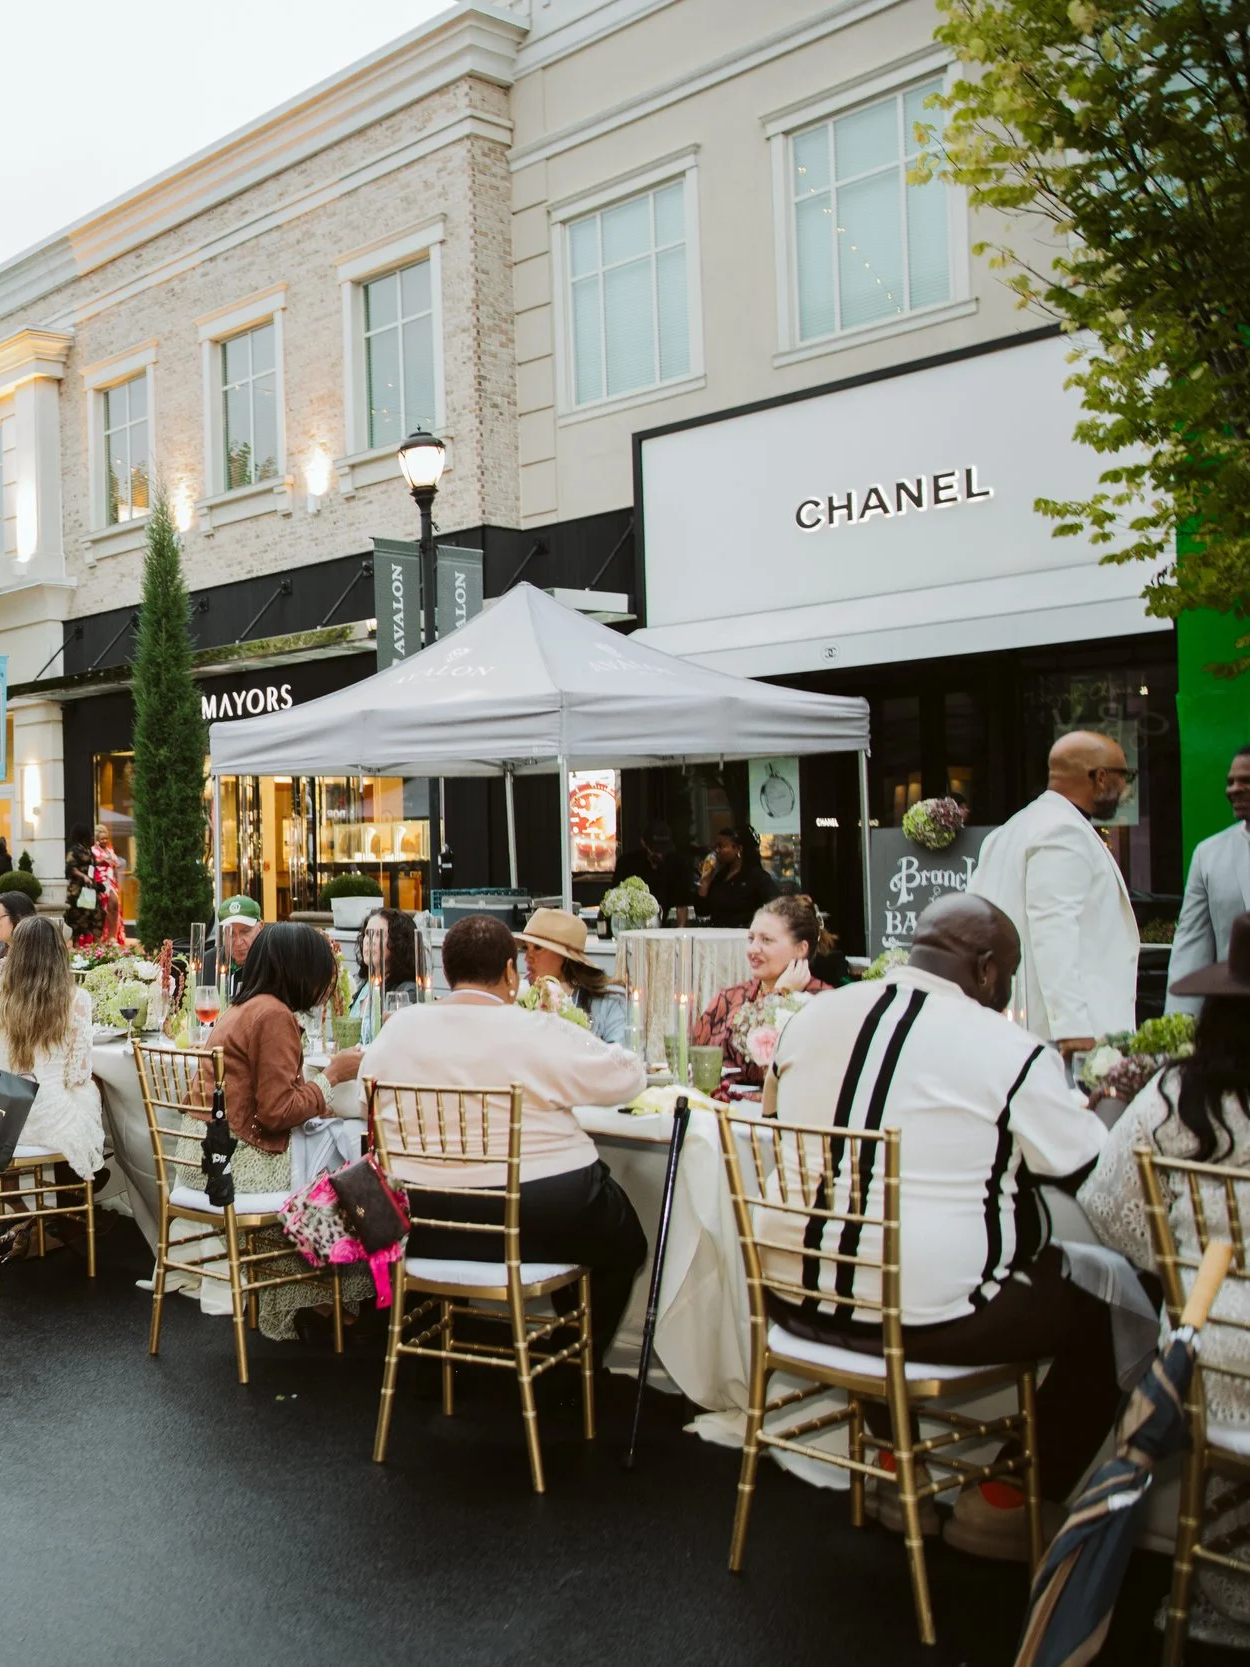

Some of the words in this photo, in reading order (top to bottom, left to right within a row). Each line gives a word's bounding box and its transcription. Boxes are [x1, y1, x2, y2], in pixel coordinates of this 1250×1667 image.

[795, 467, 991, 530] CHANEL
[391, 563, 406, 656] AVALON
[201, 683, 293, 719] MAYORS
